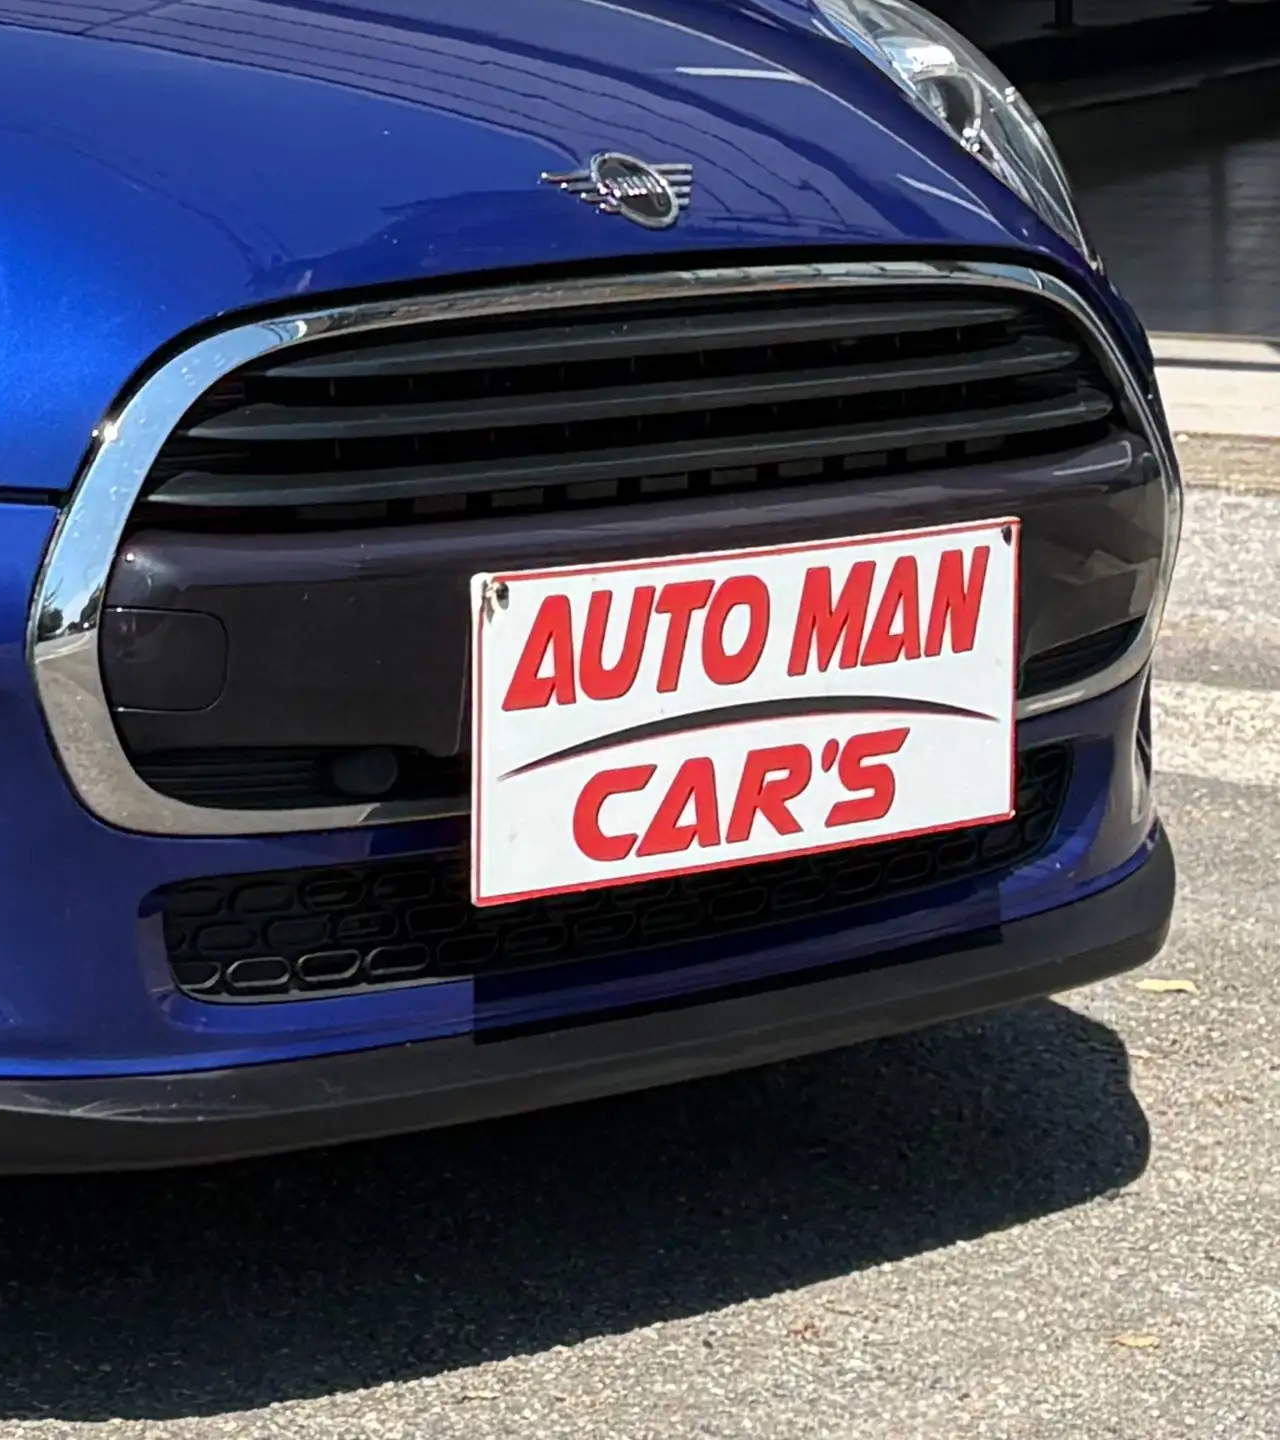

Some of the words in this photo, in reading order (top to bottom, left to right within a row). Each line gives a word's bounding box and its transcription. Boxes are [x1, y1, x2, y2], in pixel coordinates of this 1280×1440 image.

[502, 574, 770, 711] AUTO
[787, 545, 990, 677] MAN
[573, 727, 910, 862] CAR'S
